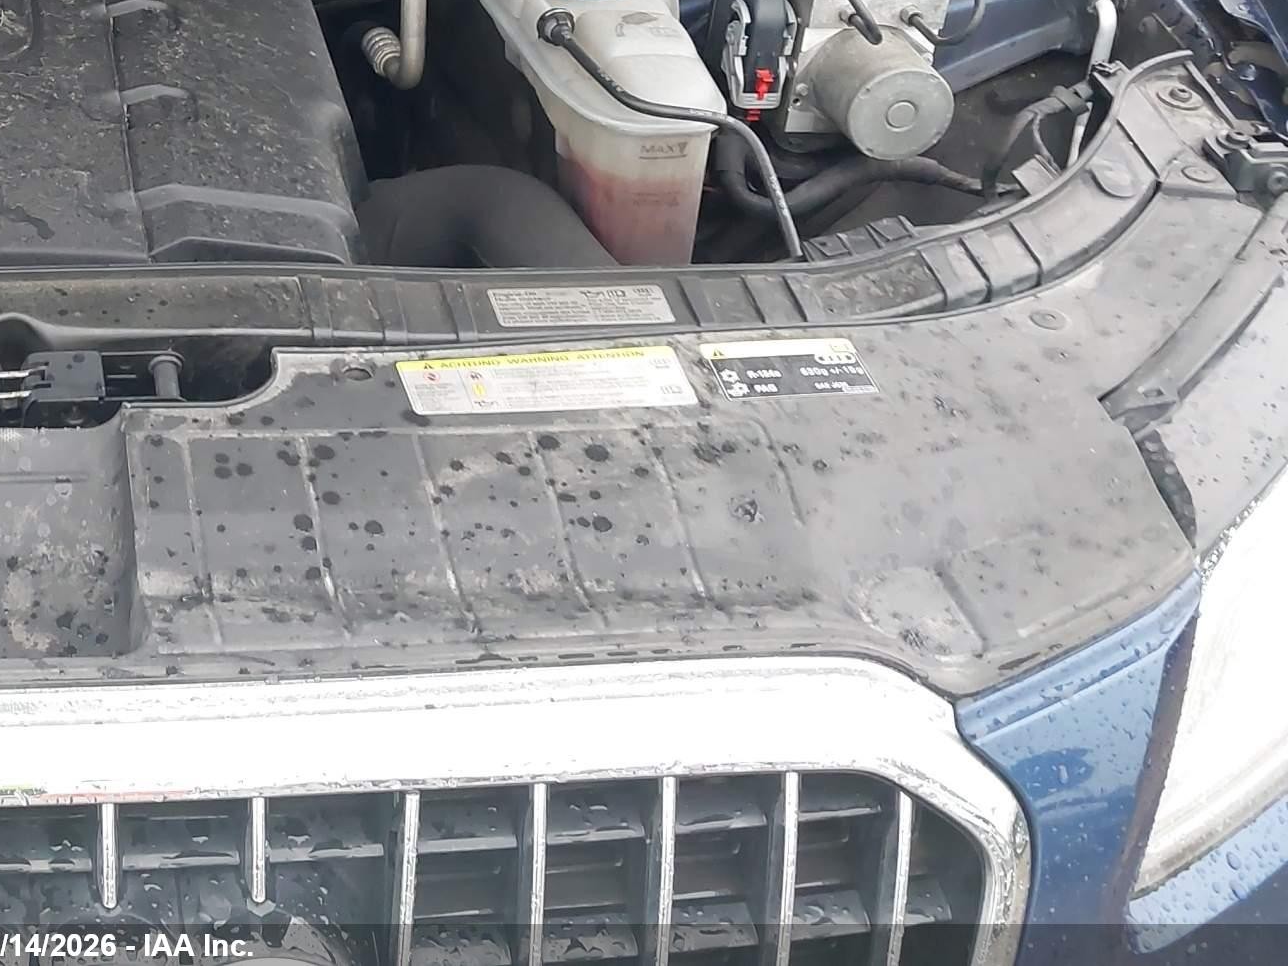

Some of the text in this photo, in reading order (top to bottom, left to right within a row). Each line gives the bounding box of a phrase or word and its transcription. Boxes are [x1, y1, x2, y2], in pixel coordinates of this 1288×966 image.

[641, 145, 674, 153] MAX
[440, 350, 646, 369] ACHTUNG WARNING ATTENTION
